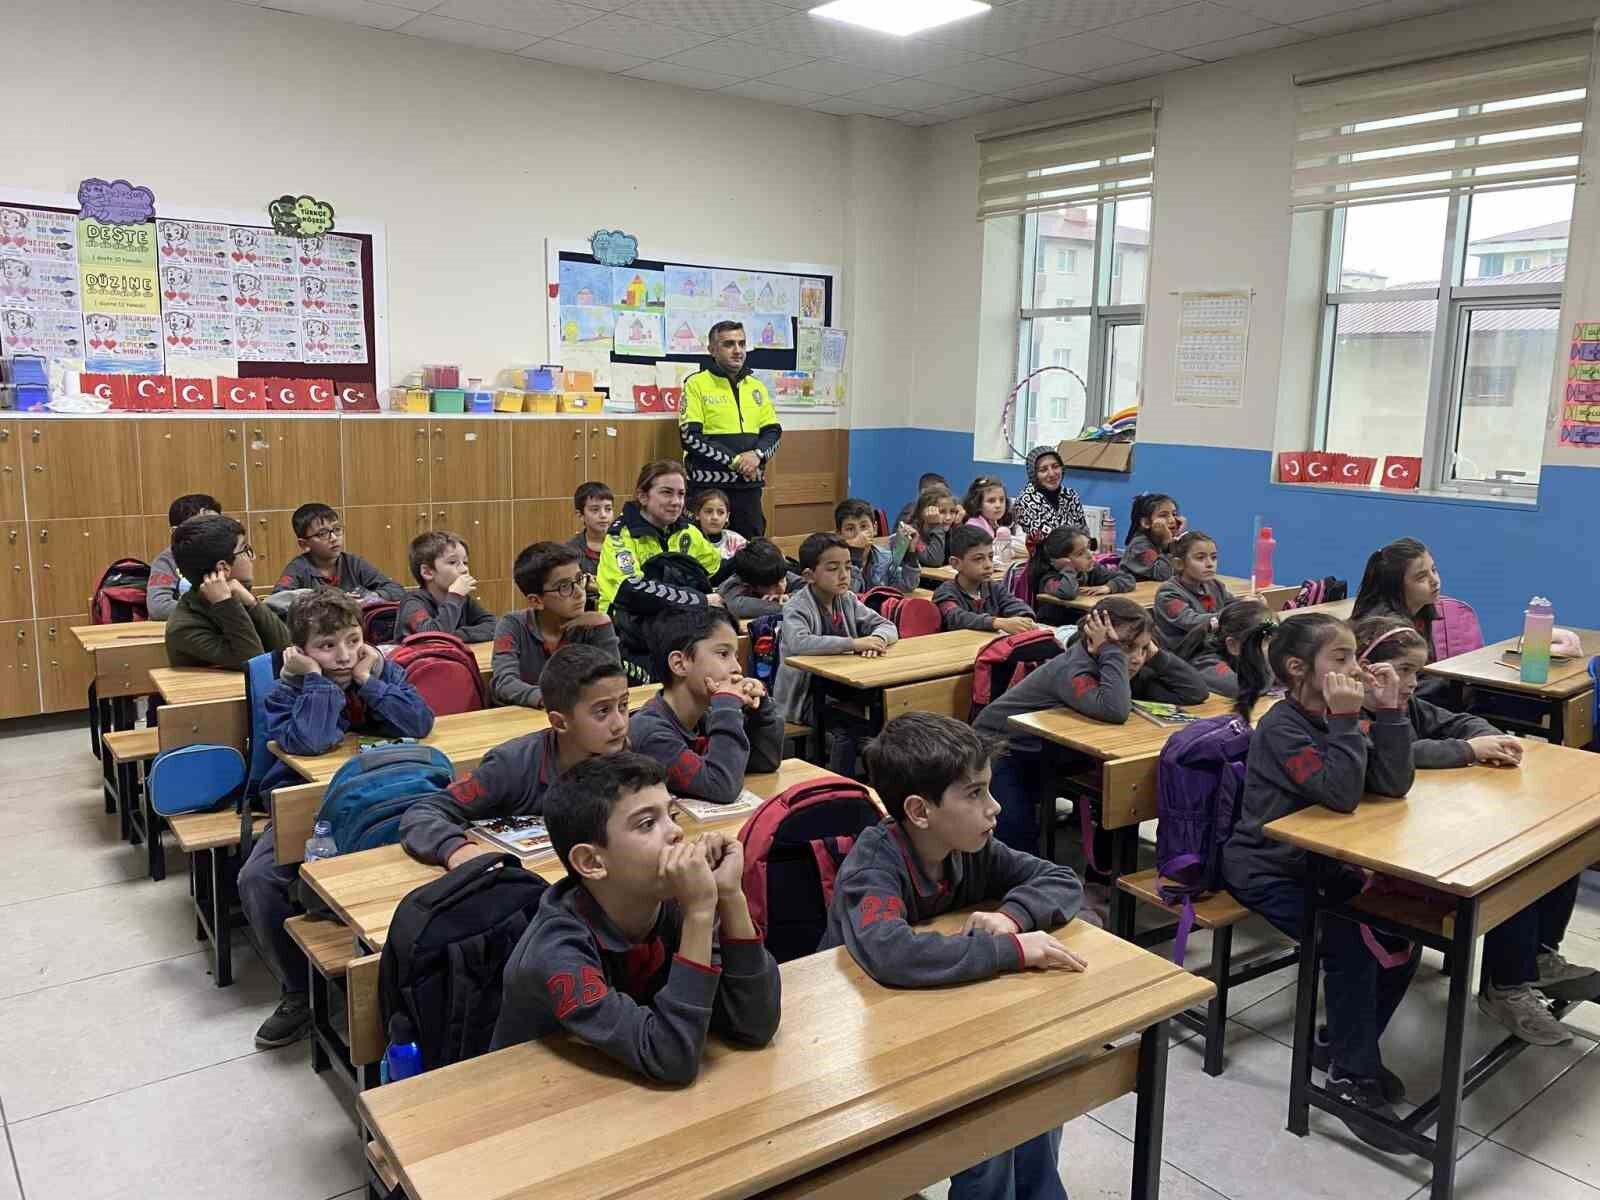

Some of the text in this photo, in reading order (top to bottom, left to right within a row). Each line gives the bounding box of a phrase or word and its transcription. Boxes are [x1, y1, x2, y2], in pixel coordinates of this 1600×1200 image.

[300, 209, 326, 217] TÜRKÇE
[86, 224, 149, 245] DESTE
[86, 272, 153, 290] DÜZİNE
[546, 965, 608, 1019] 25
